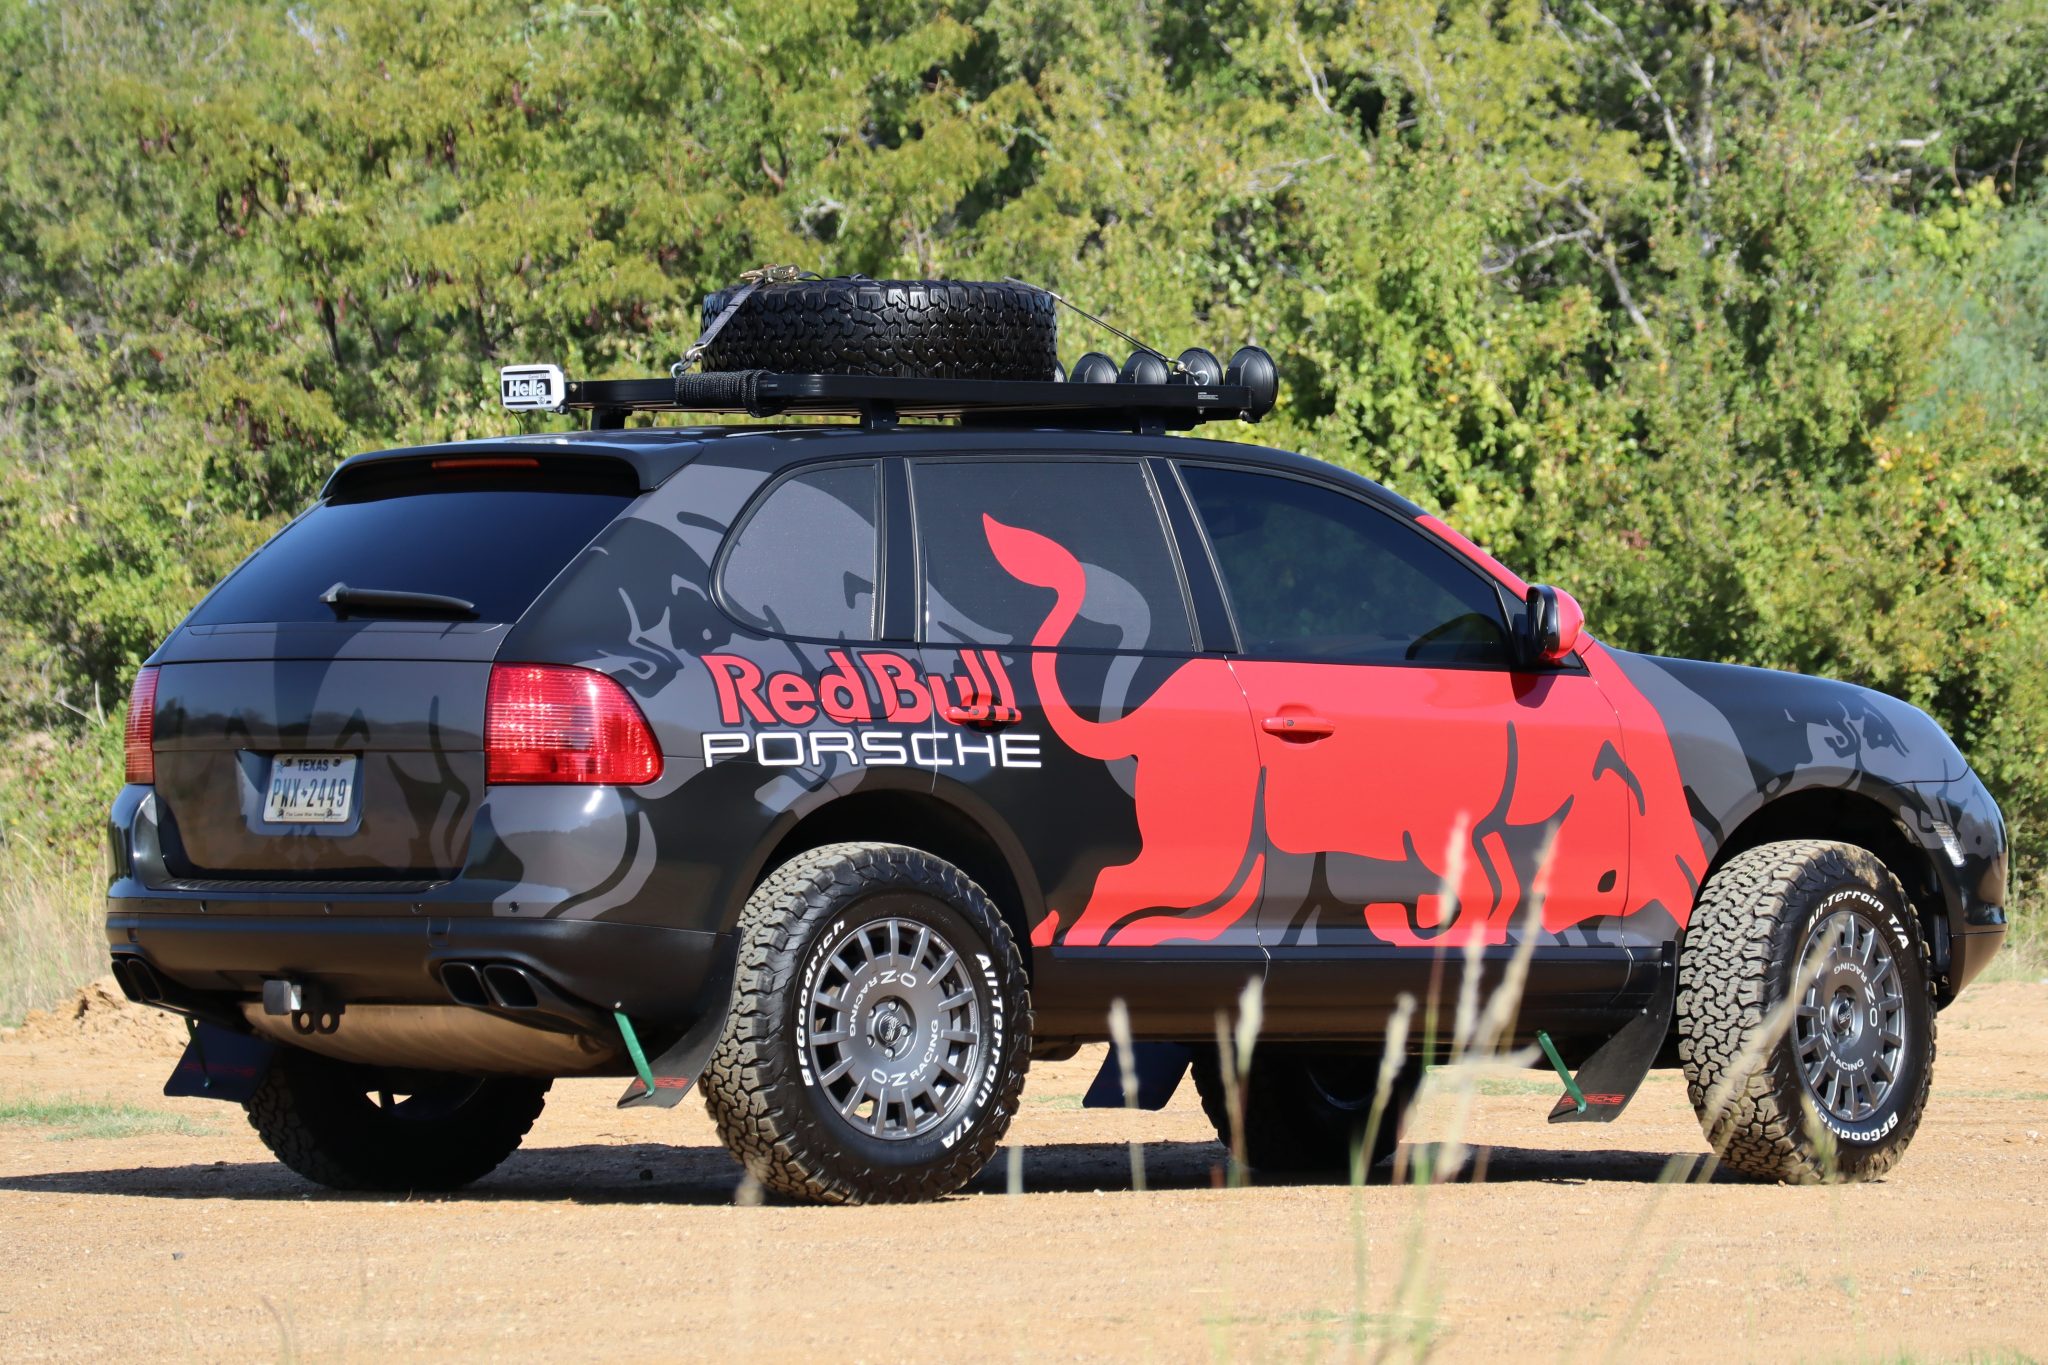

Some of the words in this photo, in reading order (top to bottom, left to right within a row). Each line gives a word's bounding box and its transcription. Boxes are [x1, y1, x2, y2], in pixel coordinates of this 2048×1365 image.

[508, 380, 546, 397] Hella
[701, 650, 872, 724] Red
[297, 759, 329, 771] TEXAS
[702, 732, 1042, 768] PORSCHE
[306, 778, 347, 807] 2449
[1808, 890, 1885, 934] All-Terrain
[1833, 962, 1868, 983] RACING
[796, 919, 846, 1087] BFGoodrich
[849, 976, 878, 1037] RACING
[909, 1019, 939, 1081] RACING
[975, 953, 1004, 1108] All-Terrain
[1830, 1050, 1864, 1071] RACING
